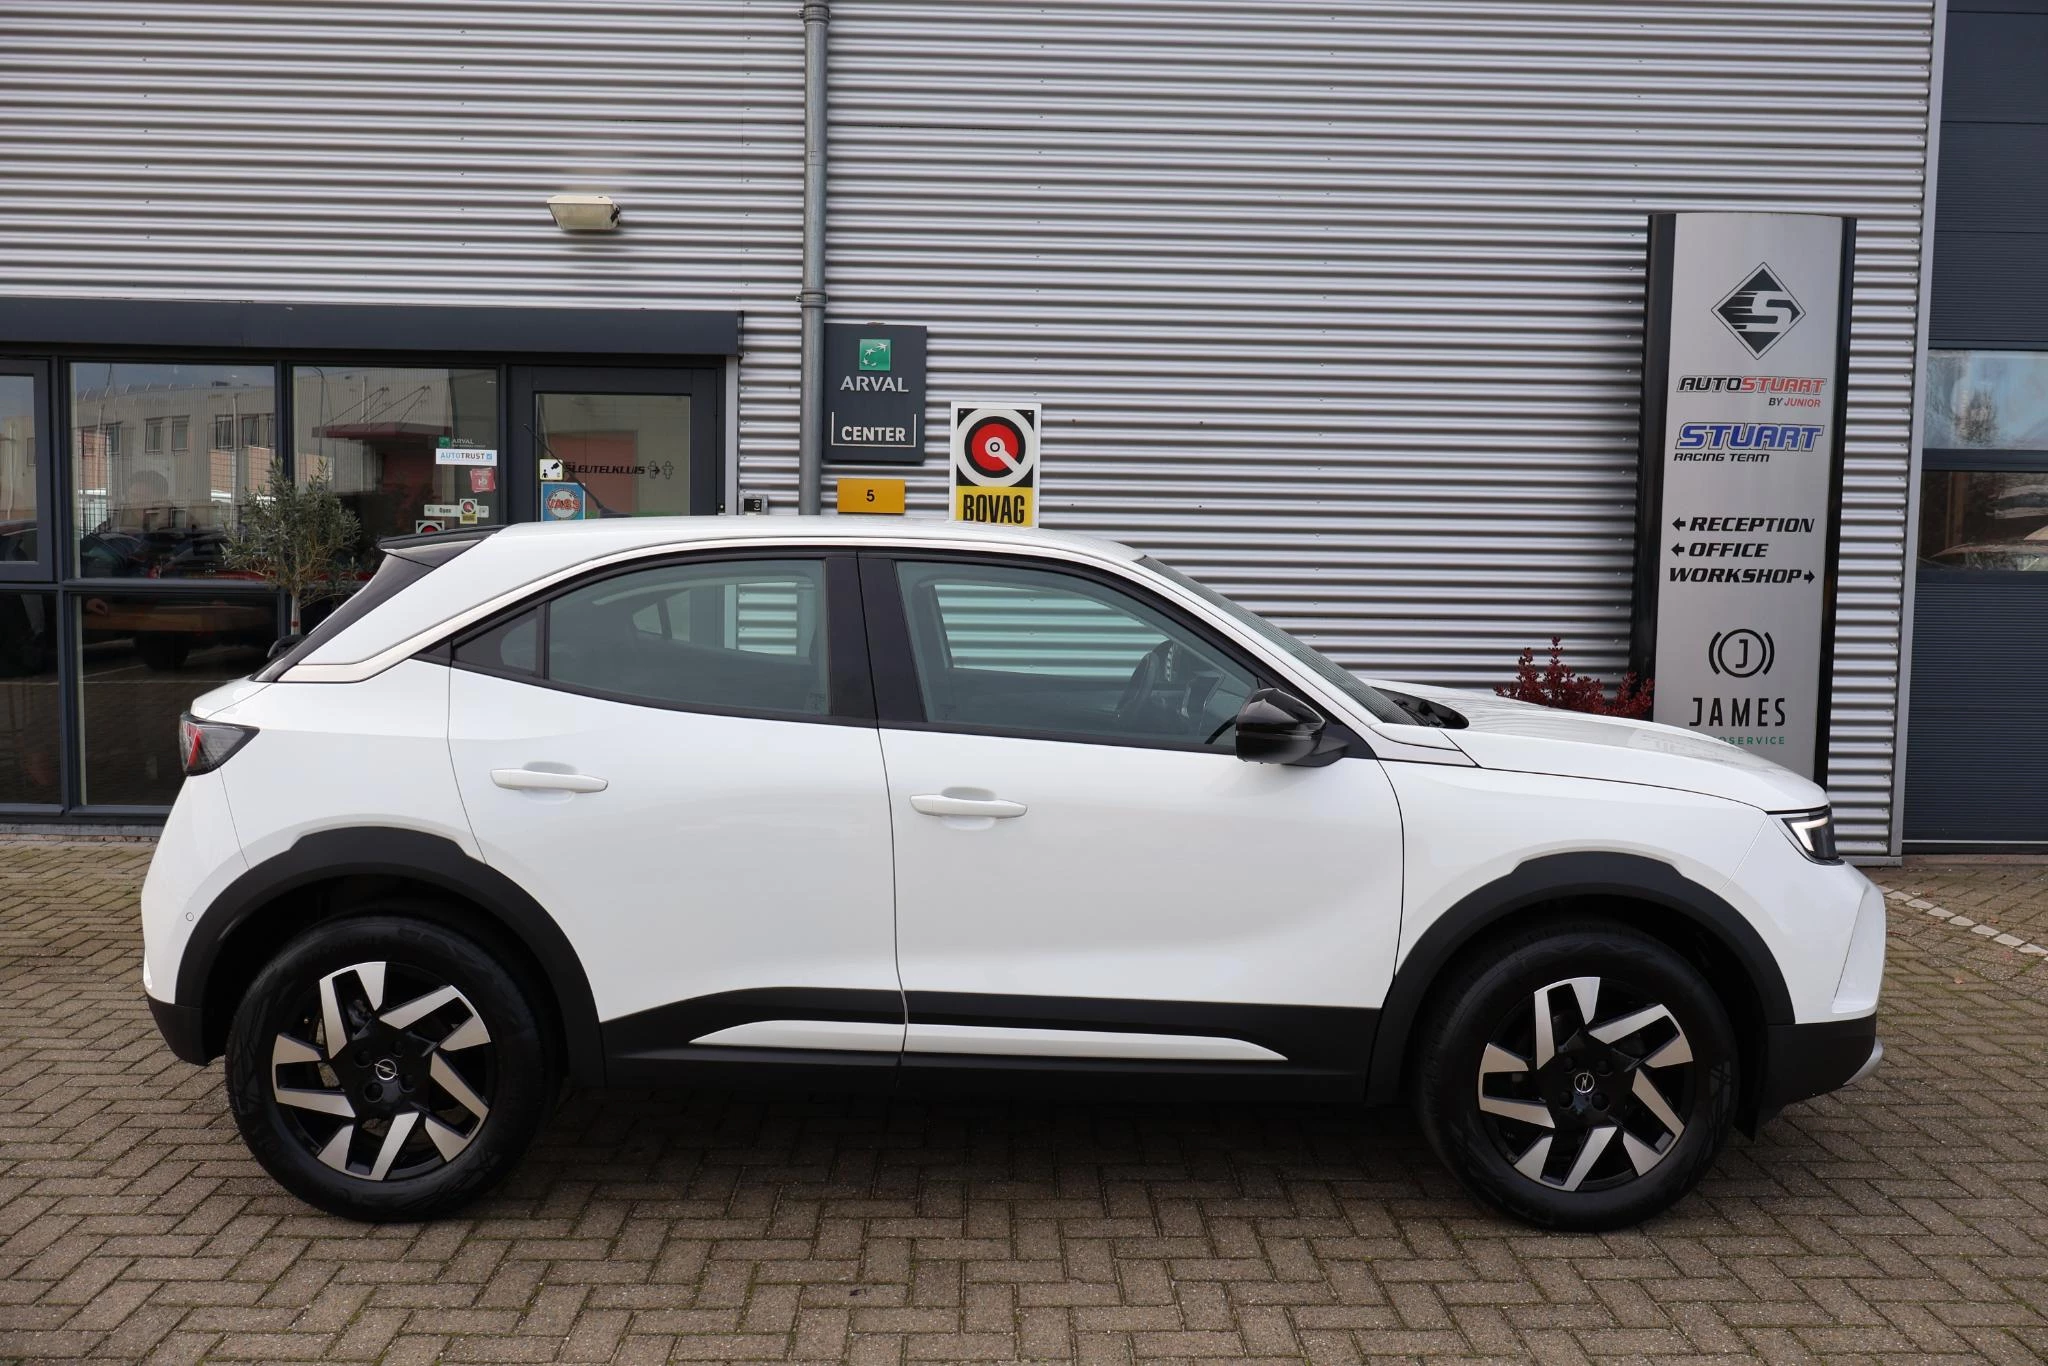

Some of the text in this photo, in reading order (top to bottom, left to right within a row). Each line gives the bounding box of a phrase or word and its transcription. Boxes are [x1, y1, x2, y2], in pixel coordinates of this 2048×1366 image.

[839, 375, 909, 393] ARVAL
[1677, 376, 1826, 395] AUTOSTUART
[1768, 397, 1821, 408] BY JUNIOR
[841, 426, 906, 442] CENTER
[1676, 423, 1823, 451] STUART
[440, 452, 486, 460] AUTOTRUST
[1673, 453, 1770, 463] RACING TEAM
[865, 489, 876, 502] 5
[962, 493, 1026, 524] BOVAG
[1689, 516, 1815, 533] RECEPTION
[1688, 542, 1769, 558] OFFICE
[1669, 567, 1801, 584] WORKSHOP
[1688, 697, 1786, 727] JAMES
